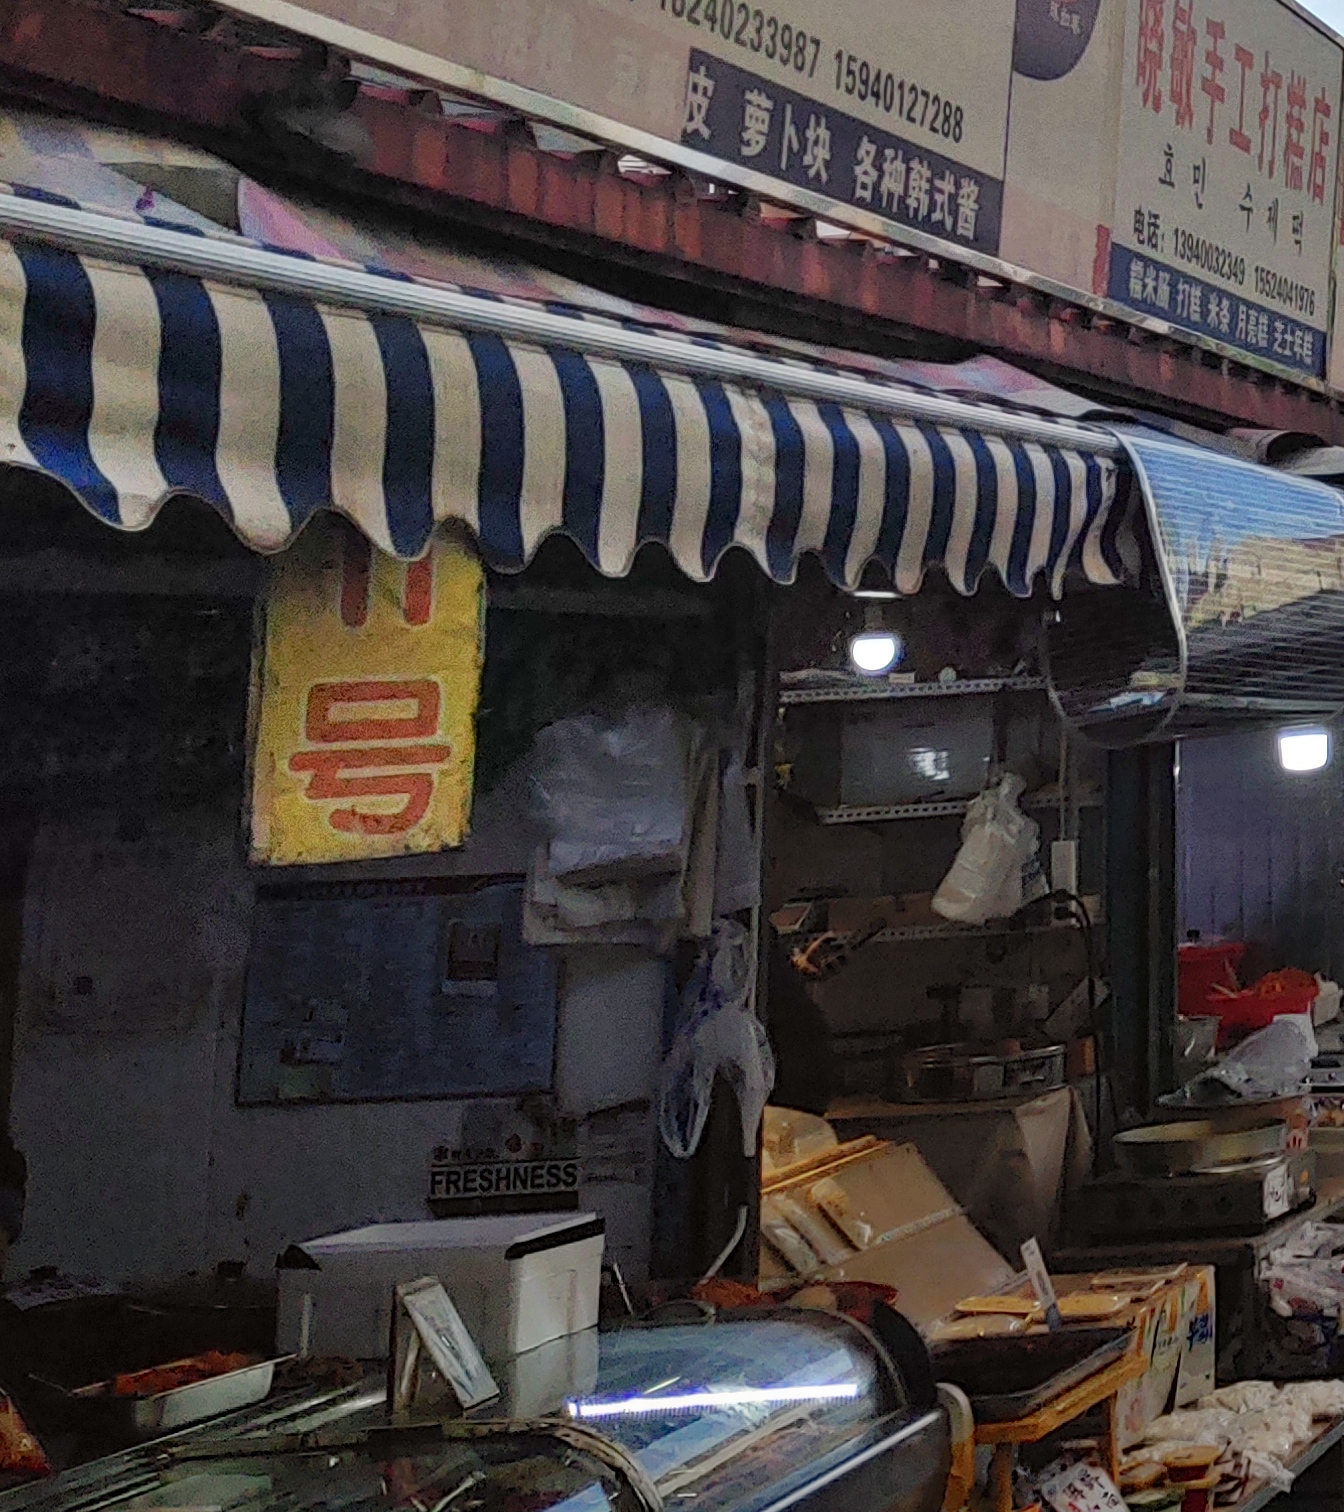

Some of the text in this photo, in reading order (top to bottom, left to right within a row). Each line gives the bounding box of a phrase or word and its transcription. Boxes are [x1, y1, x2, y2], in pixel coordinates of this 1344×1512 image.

[835, 49, 963, 144] 15940127288
[740, 87, 831, 184] 萝卜块
[853, 135, 980, 242] 各种韩式酱
[430, 1162, 578, 1198] FRESHNESS
